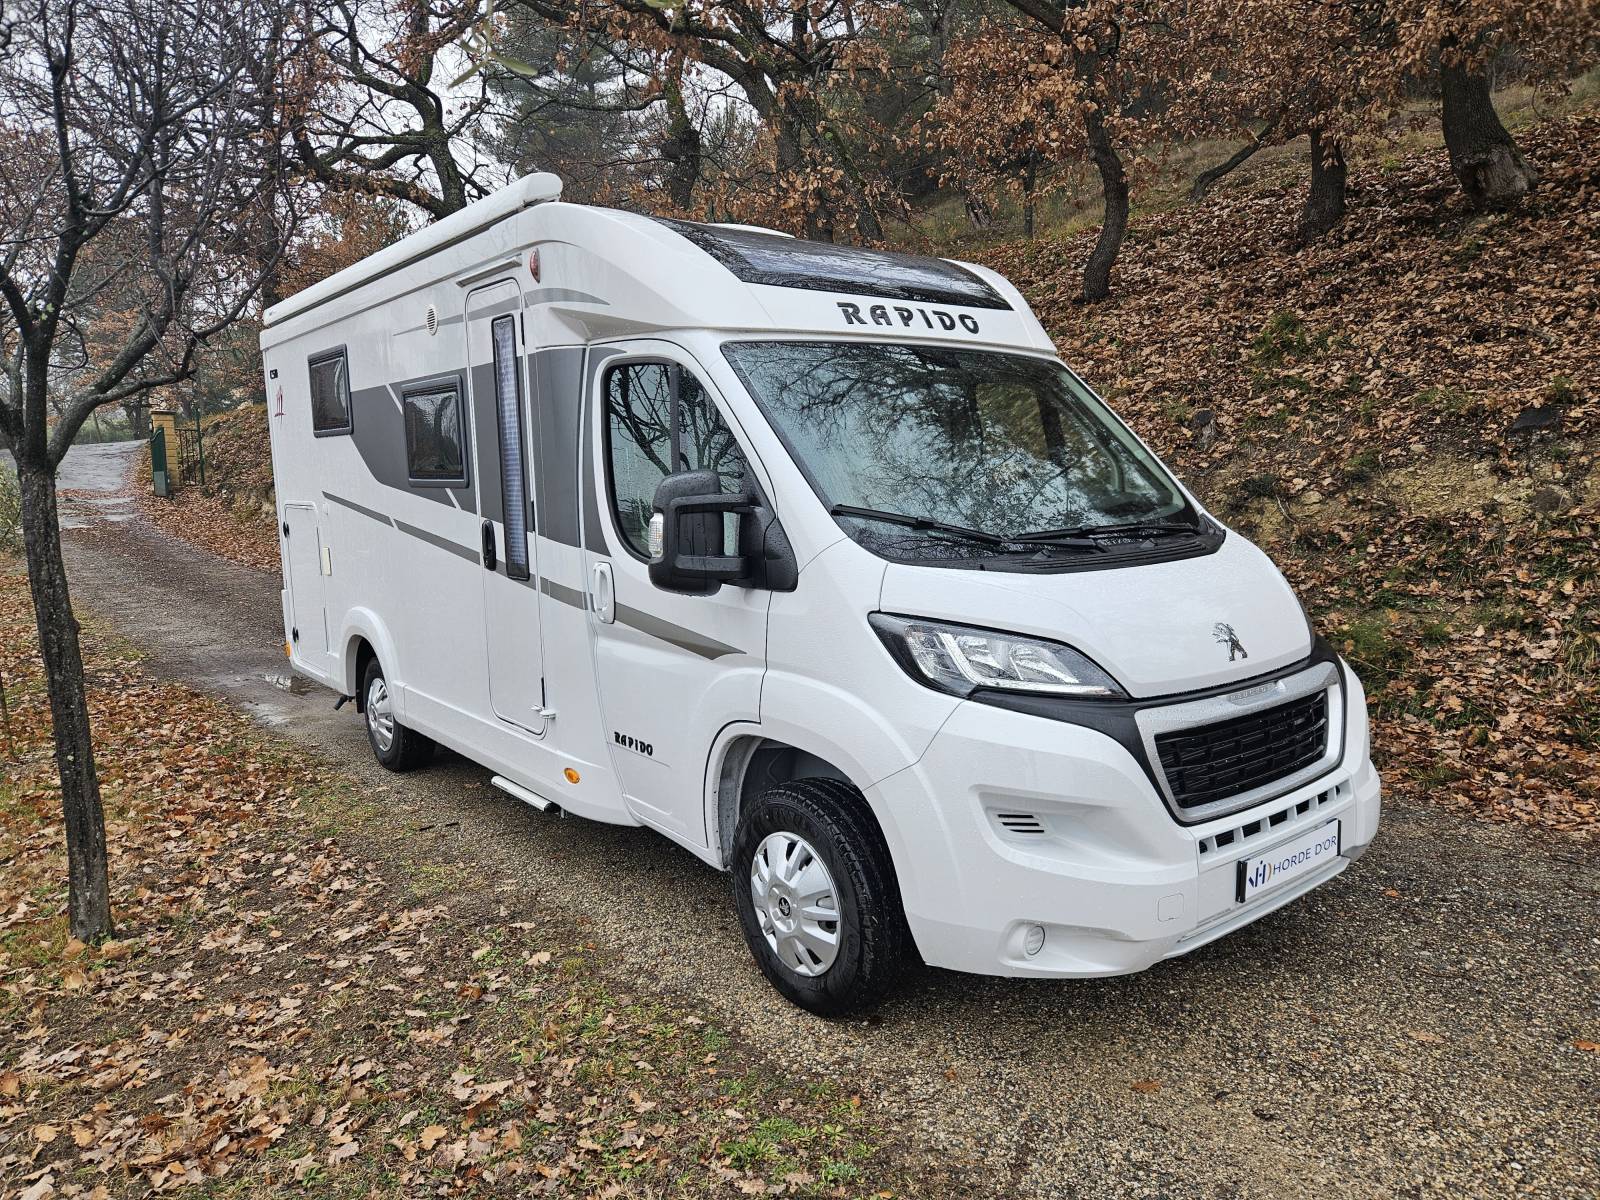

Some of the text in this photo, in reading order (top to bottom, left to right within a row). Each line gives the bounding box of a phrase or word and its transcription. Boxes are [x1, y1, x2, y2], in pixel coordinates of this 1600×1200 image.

[836, 302, 980, 334] RAPIDO
[614, 731, 653, 756] RAPIDO
[1273, 847, 1312, 875] HORDE
[1314, 835, 1337, 856] D'OR
